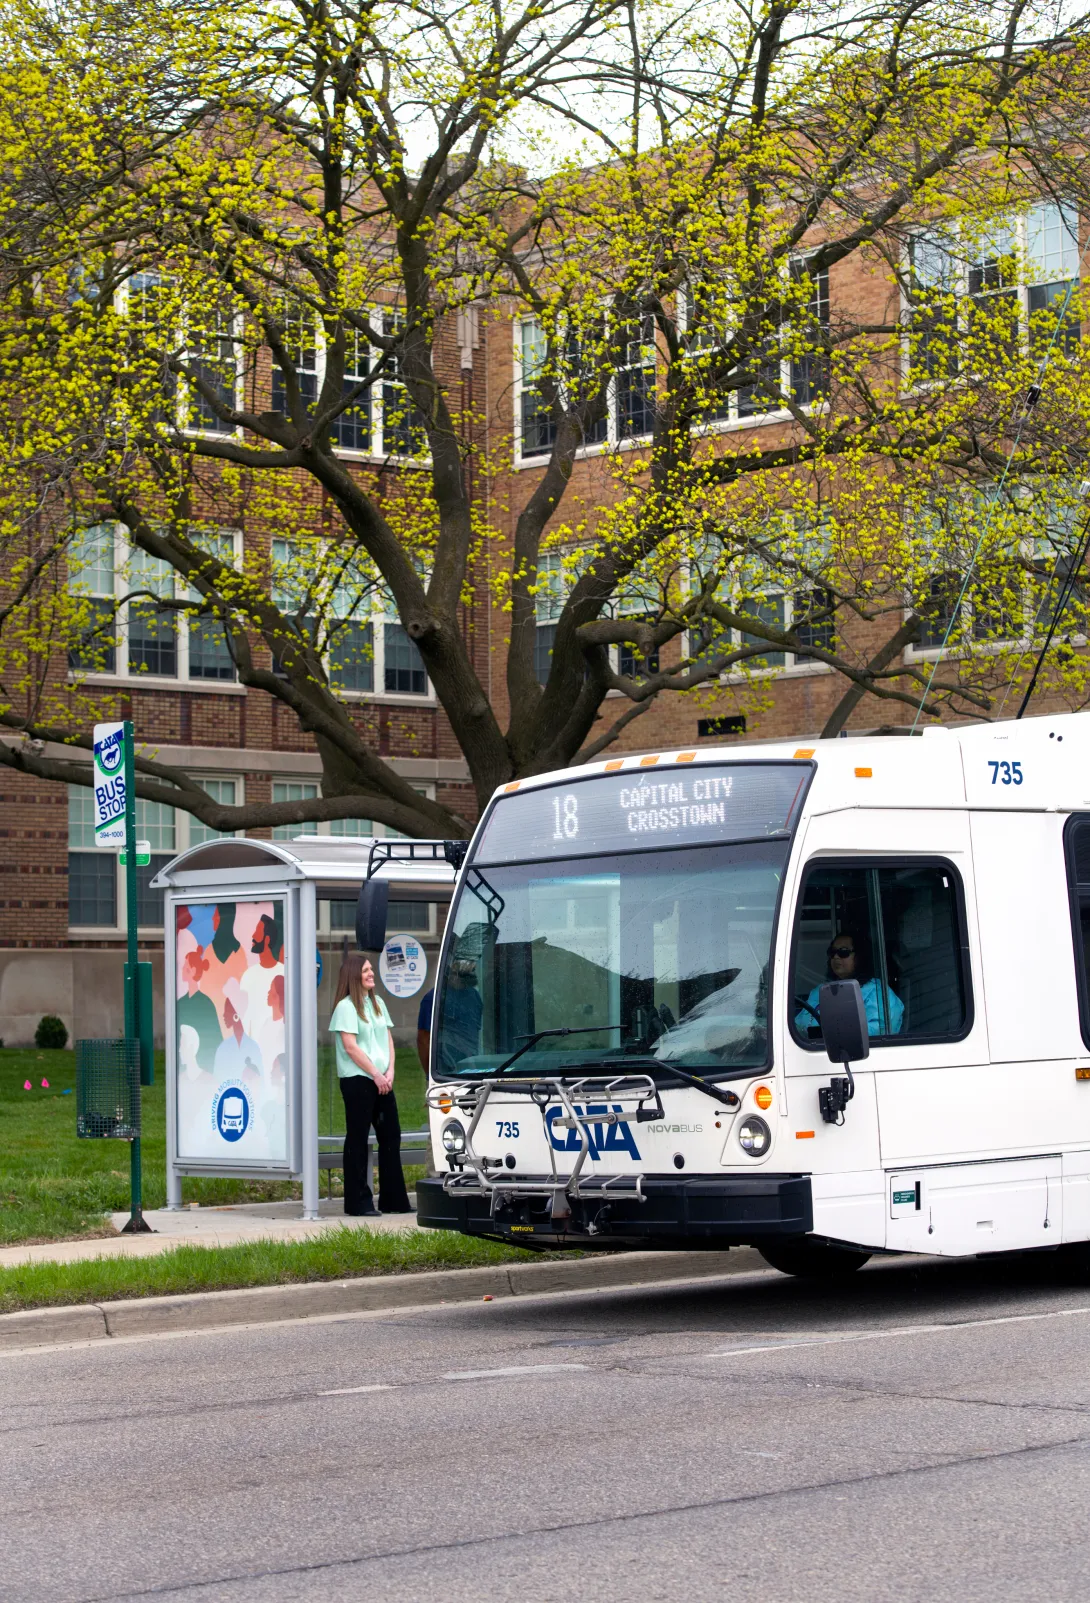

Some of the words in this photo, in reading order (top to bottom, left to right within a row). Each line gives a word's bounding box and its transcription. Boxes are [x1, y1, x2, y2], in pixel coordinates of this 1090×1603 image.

[100, 734, 119, 751] CATA
[988, 761, 1023, 785] 735
[96, 776, 126, 806] BUS
[620, 782, 688, 808] CAPITAL
[693, 777, 732, 800] CITY
[99, 795, 126, 821] STOP
[553, 795, 579, 839] 18
[627, 802, 725, 832] CROSSTOWN
[100, 830, 123, 838] 394-1000
[211, 1093, 219, 1131] DRIVING
[217, 1078, 243, 1094] MOBILITY
[243, 1084, 255, 1132] SOLUTIONS
[496, 1121, 520, 1138] 735
[545, 1105, 642, 1160] CATA
